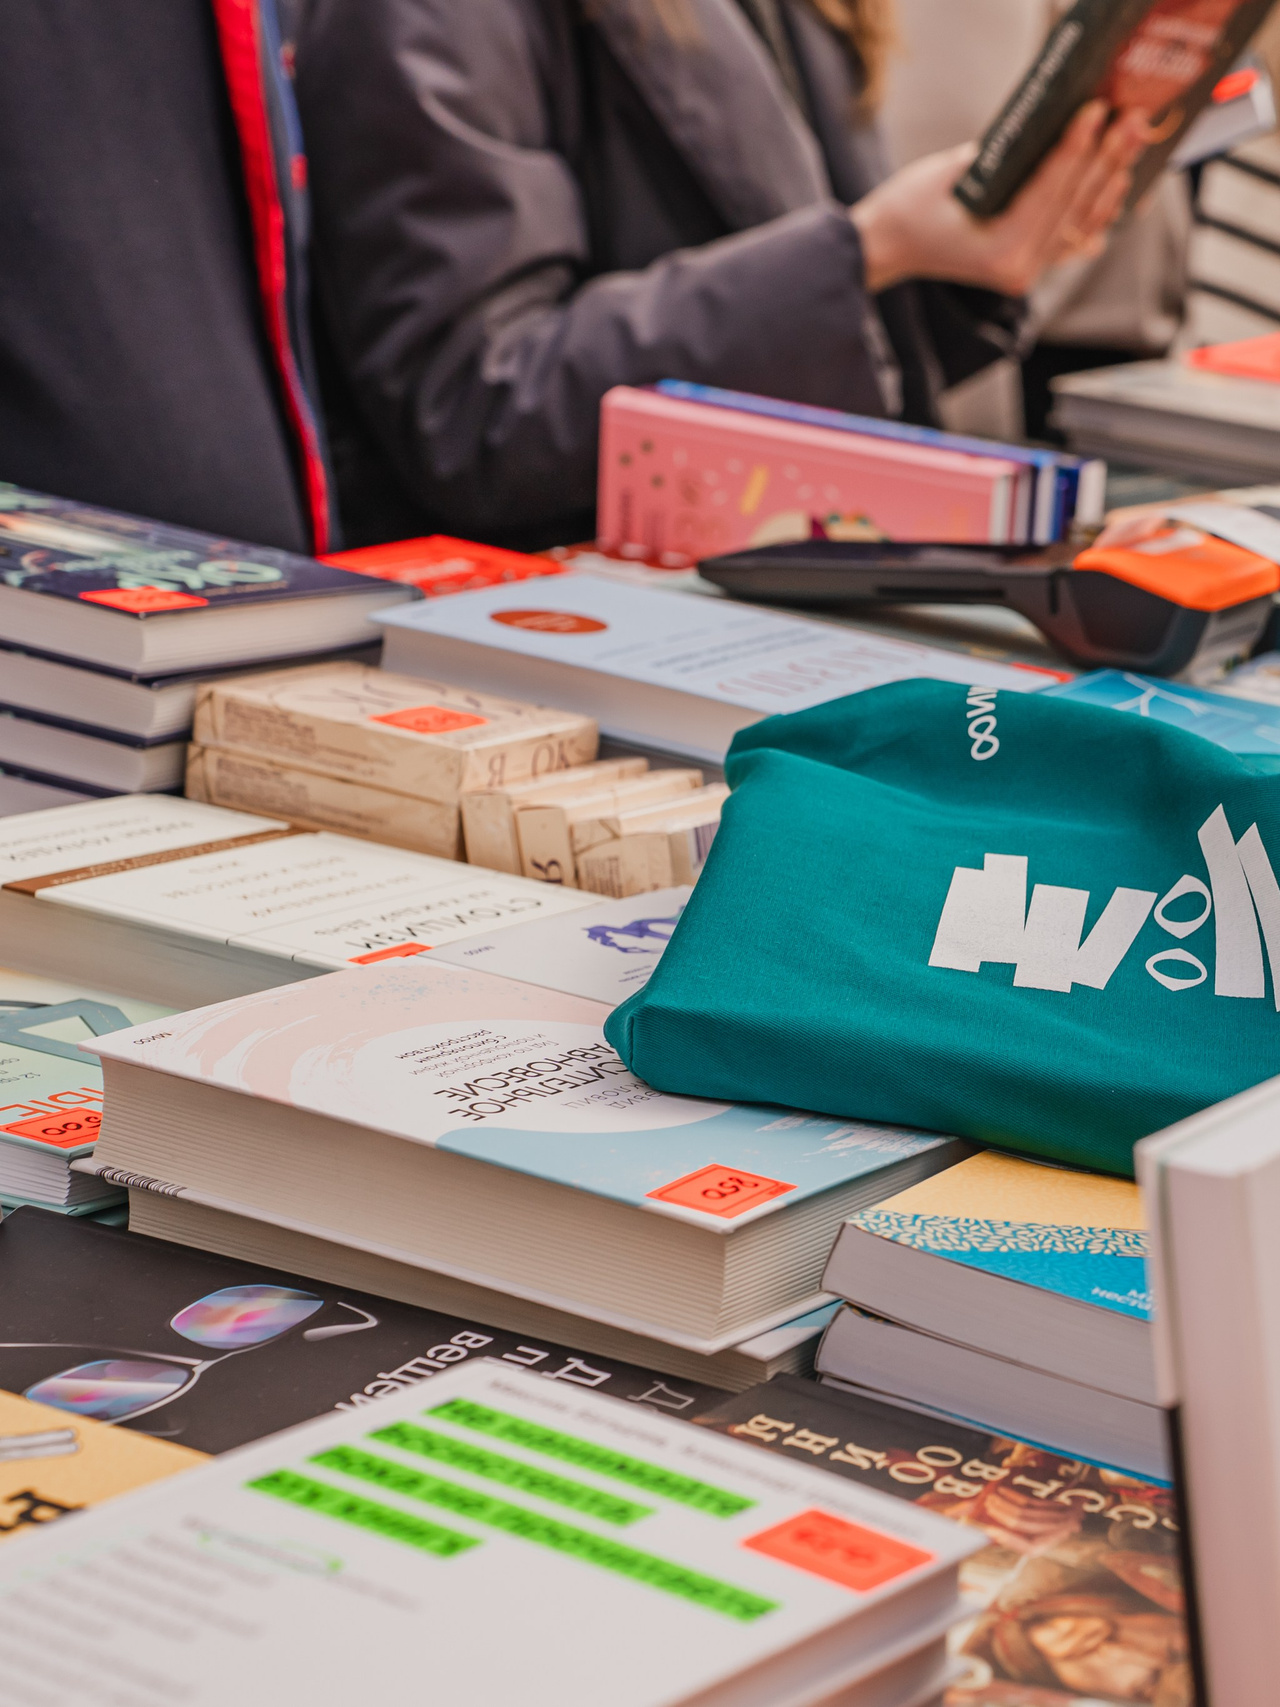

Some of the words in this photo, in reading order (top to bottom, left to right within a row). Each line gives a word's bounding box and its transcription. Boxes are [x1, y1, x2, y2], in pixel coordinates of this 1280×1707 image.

[345, 897, 543, 950] СТОИЦИЗМ
[433, 1043, 616, 1102] АВНОВЕСИЕ
[448, 1057, 631, 1122] СИТЕЛЬНОЕ
[605, 1090, 664, 1110] ЭВИД
